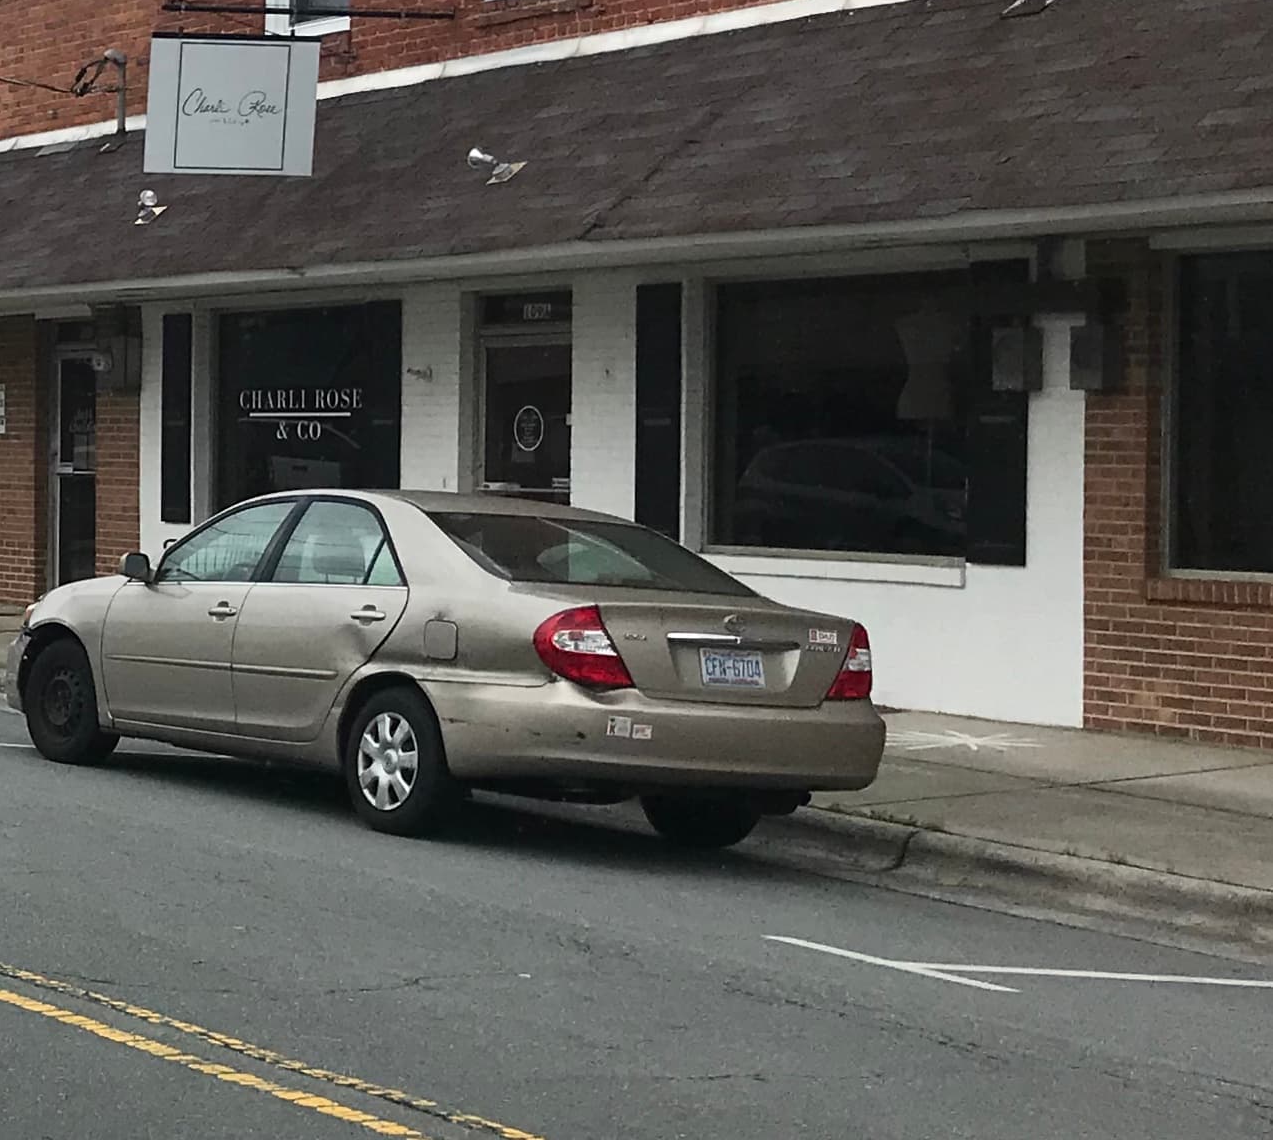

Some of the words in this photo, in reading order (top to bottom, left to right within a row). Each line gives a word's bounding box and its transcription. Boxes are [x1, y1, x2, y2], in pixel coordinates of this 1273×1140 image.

[182, 88, 231, 116] Charli
[238, 90, 282, 118] Rose
[239, 389, 305, 410] CHARLI
[315, 388, 362, 409] ROSE
[276, 420, 288, 439] &
[297, 420, 321, 440] CO
